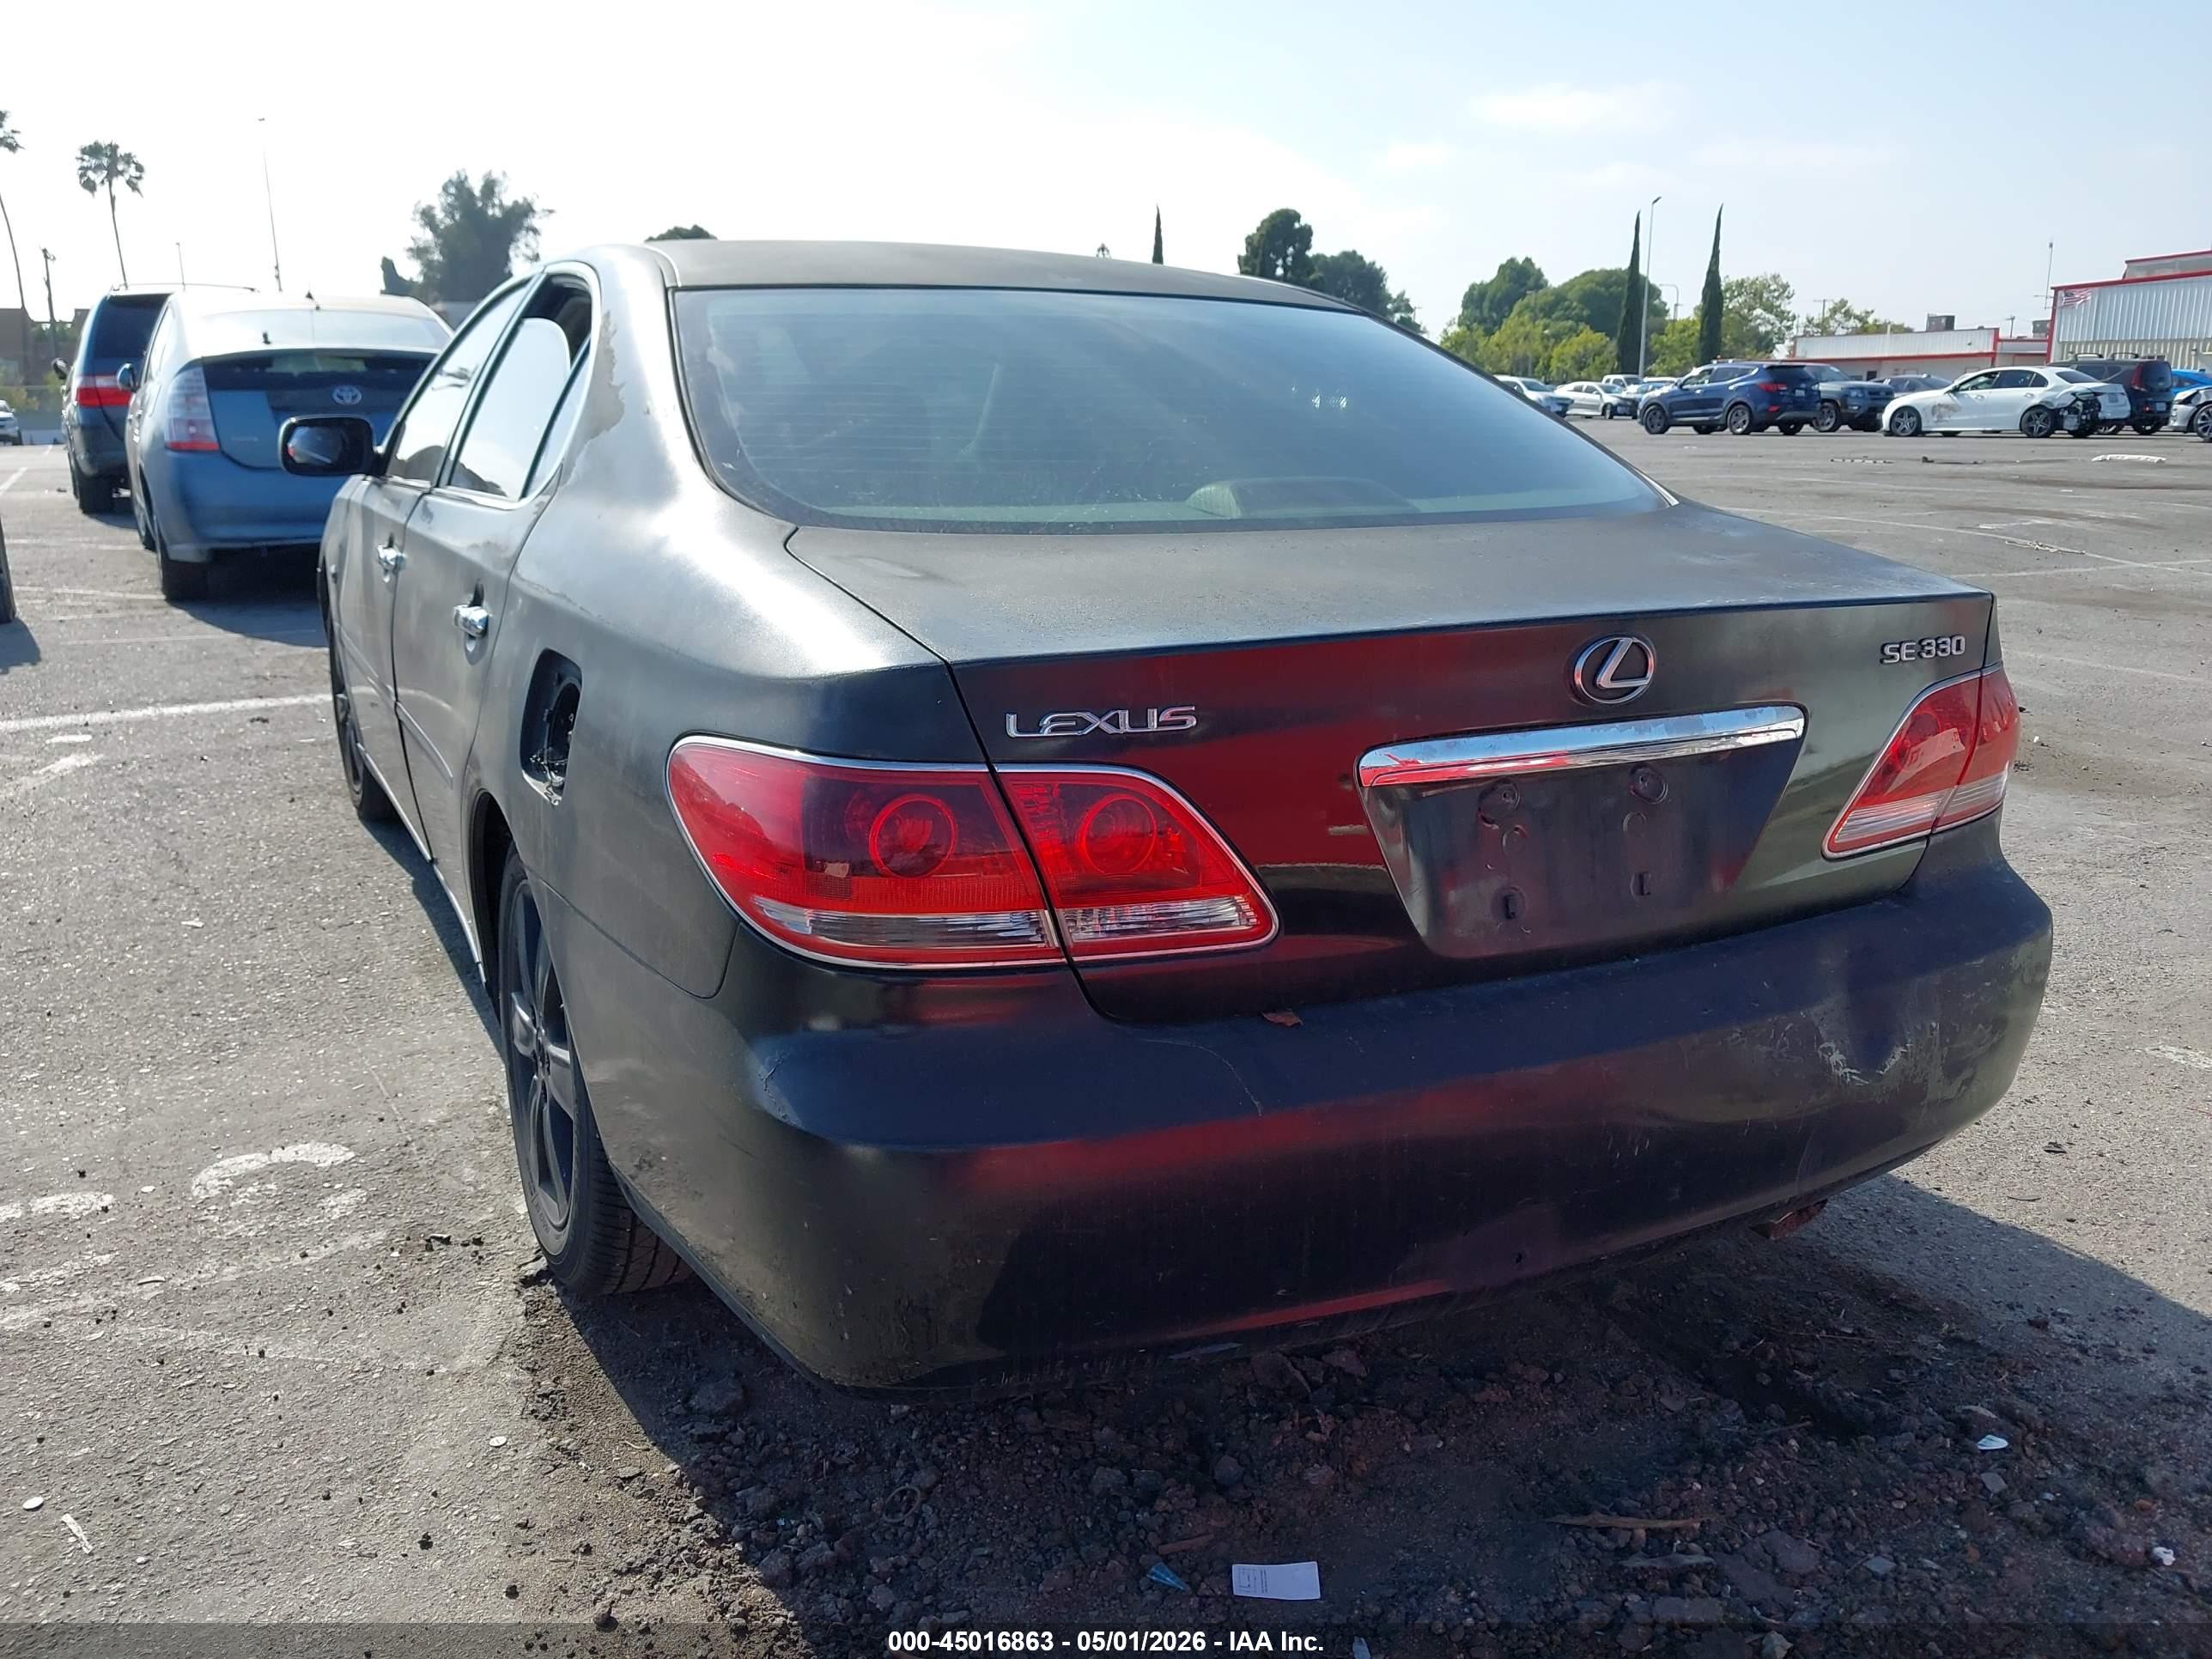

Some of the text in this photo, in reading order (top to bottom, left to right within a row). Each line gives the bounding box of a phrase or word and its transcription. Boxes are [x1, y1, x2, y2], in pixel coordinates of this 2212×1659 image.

[1882, 635, 1966, 664] SE 330
[1006, 705, 1197, 738] LEXUS
